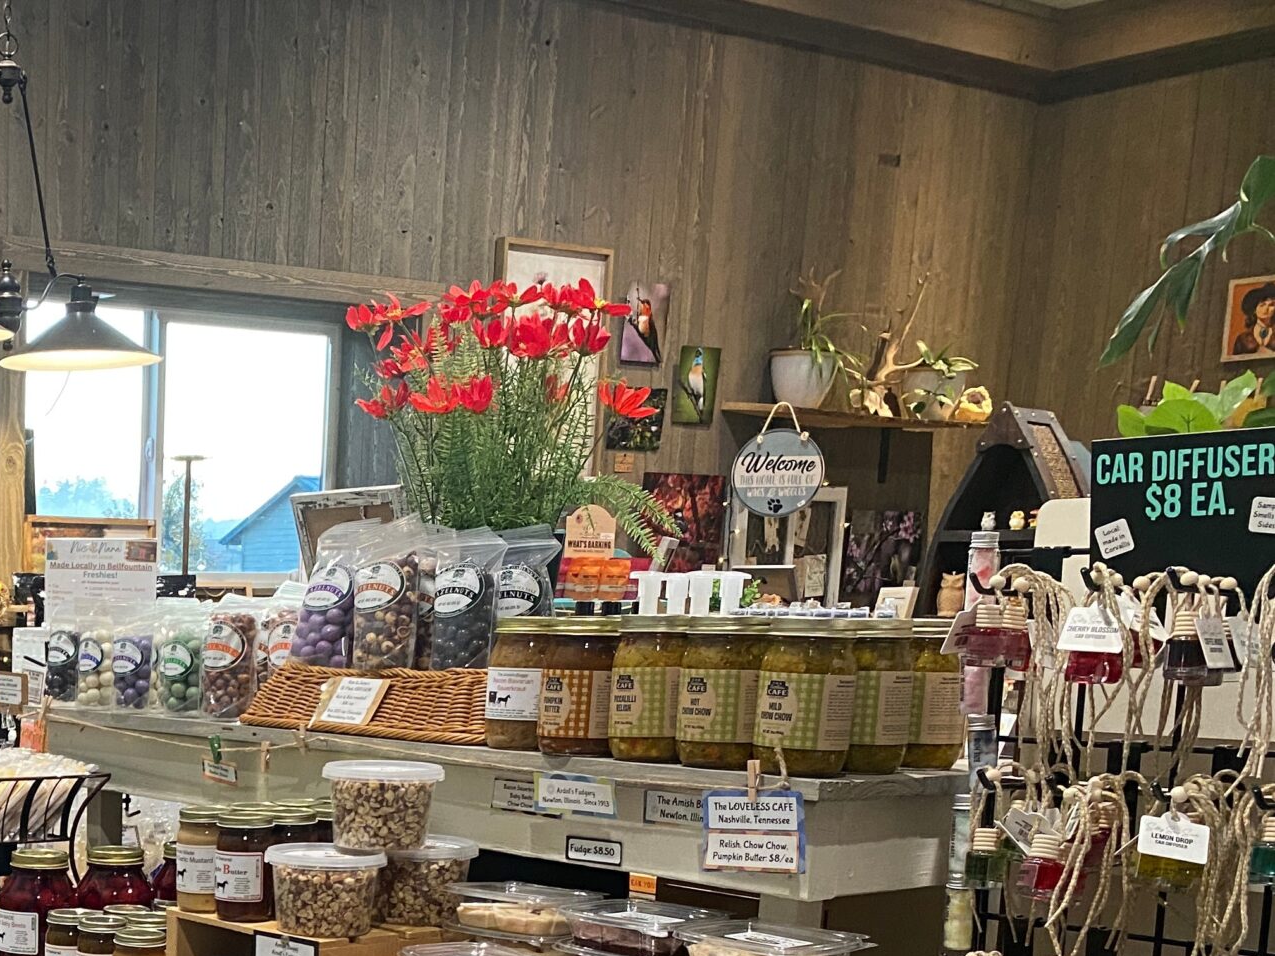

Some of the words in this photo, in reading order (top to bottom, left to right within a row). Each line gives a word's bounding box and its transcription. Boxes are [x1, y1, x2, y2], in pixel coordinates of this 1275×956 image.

[741, 451, 816, 474] Welcome
[1096, 451, 1144, 486] CAR
[1145, 483, 1182, 521] $8
[1191, 482, 1235, 517] EA.
[50, 562, 70, 570] Made
[71, 562, 97, 571] Locally
[107, 563, 152, 572] Bellfountain
[83, 571, 118, 579] Freshies!
[1067, 625, 1090, 633] CHERRY
[546, 683, 562, 691] CAFE
[616, 682, 634, 690] CAFE
[767, 688, 788, 697] CAFE
[657, 795, 670, 805] The
[672, 797, 694, 808] Amish
[714, 802, 727, 811] The
[728, 802, 771, 811] LOVELESS
[772, 803, 794, 812] CAFE
[754, 815, 791, 825] Tennessee
[1151, 832, 1174, 842] LEMON
[1175, 836, 1194, 845] DROP
[743, 840, 764, 850] Chow
[593, 846, 615, 857] $8.50
[712, 851, 743, 864] Pumpkin
